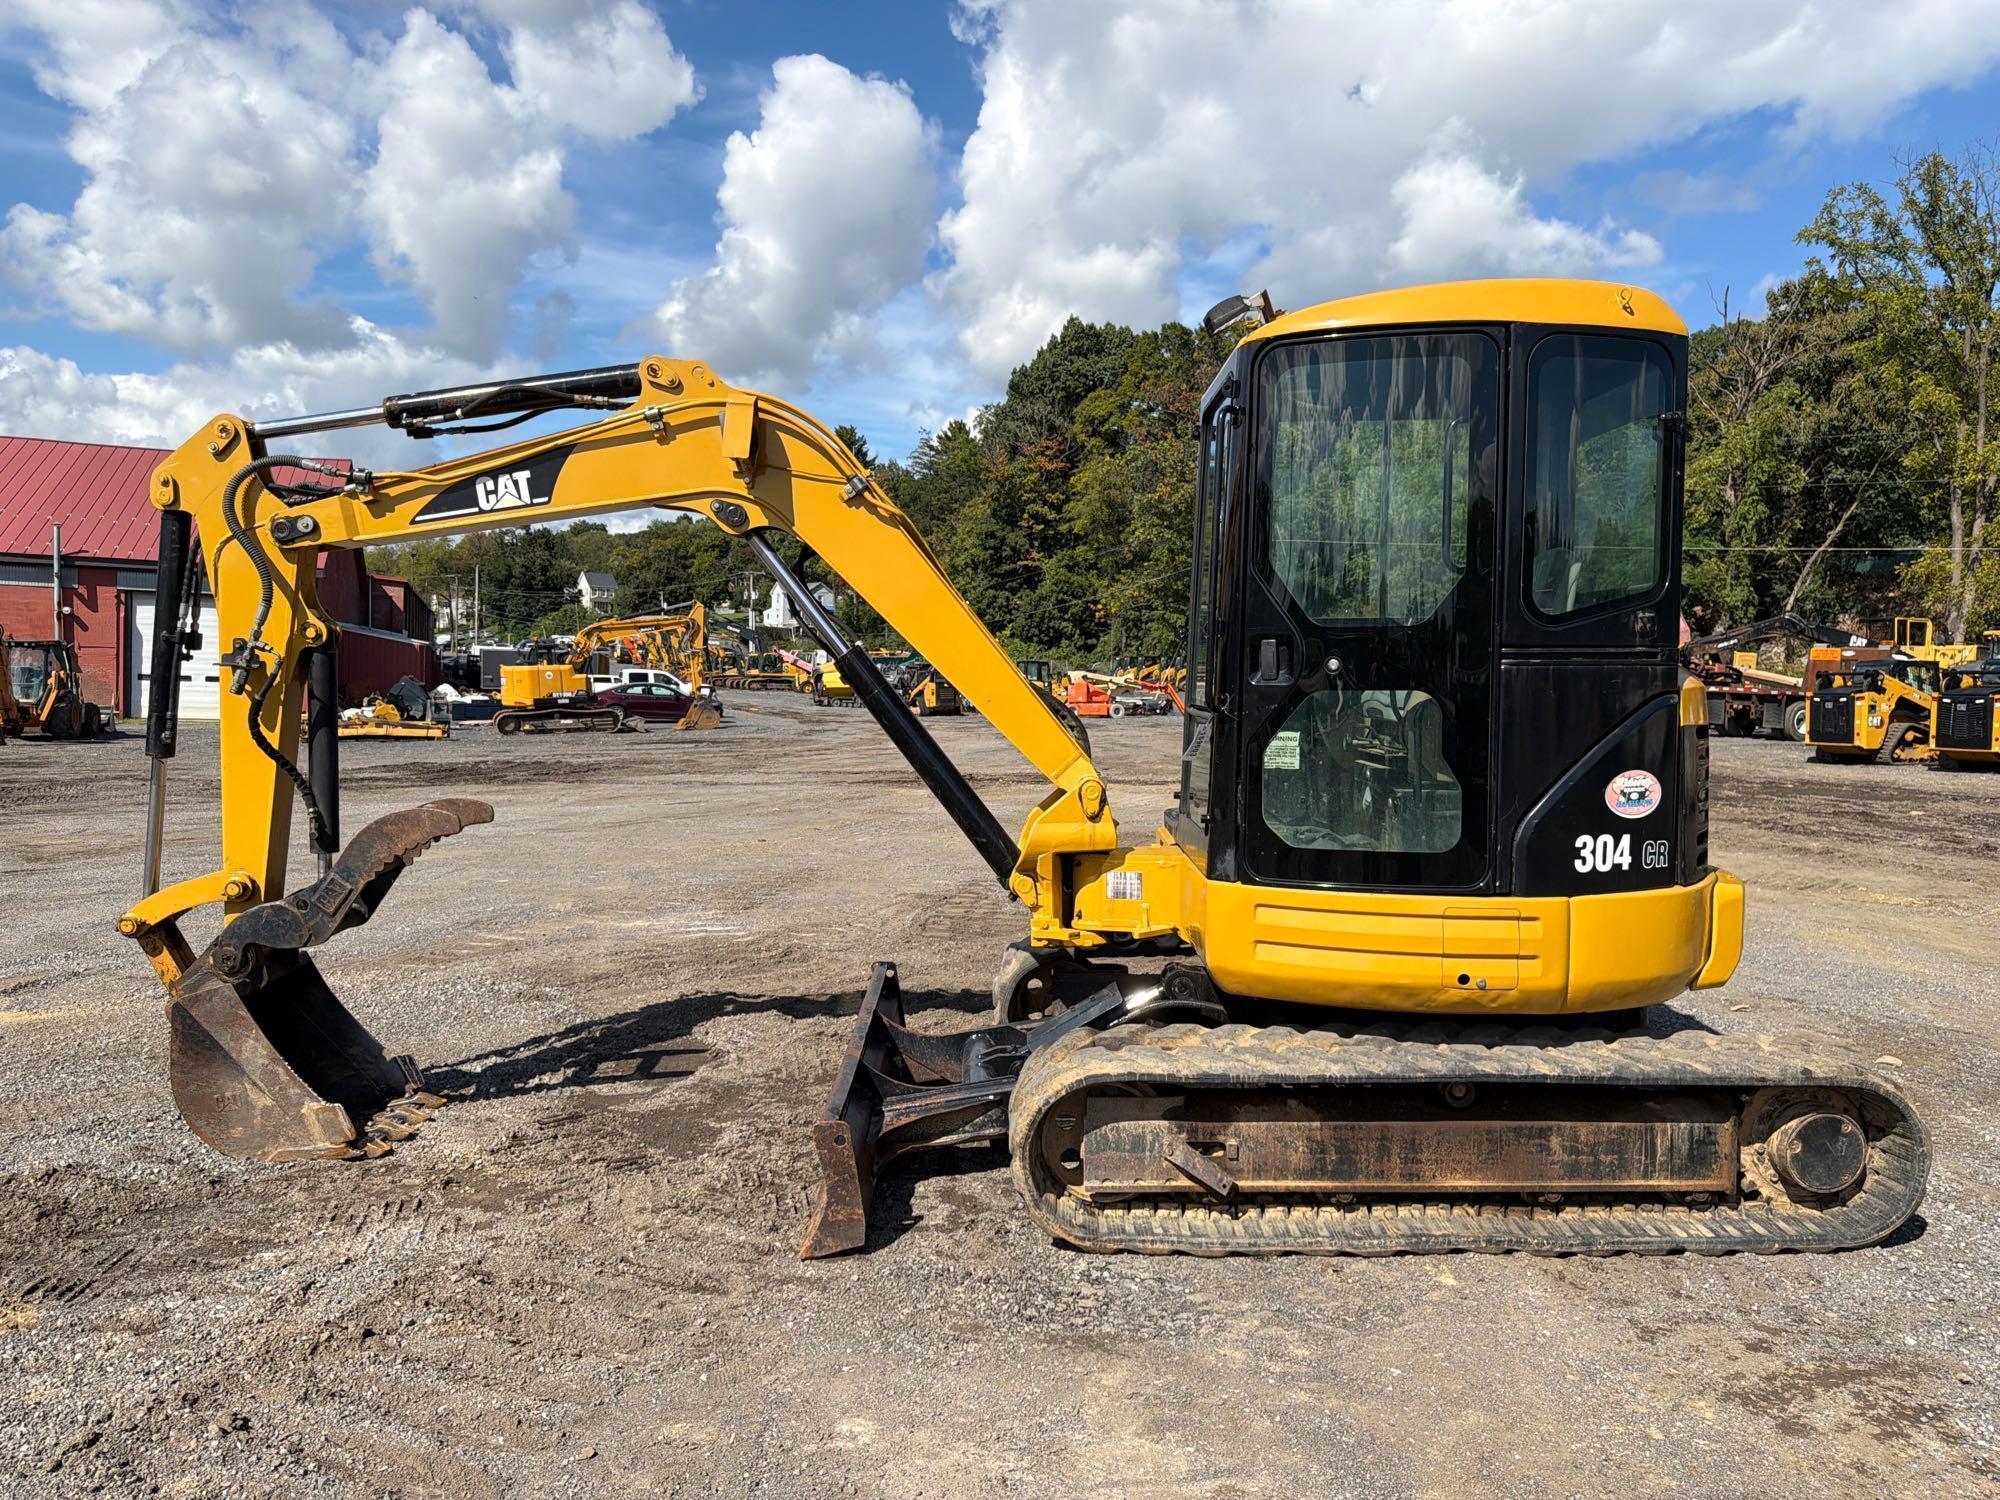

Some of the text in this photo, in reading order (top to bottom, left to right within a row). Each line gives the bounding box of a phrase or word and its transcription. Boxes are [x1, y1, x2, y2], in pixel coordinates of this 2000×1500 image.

[475, 470, 531, 511] CAT
[1849, 635, 1868, 647] CAT
[1868, 716, 1882, 727] CAT
[1574, 834, 1668, 873] 304 CR
